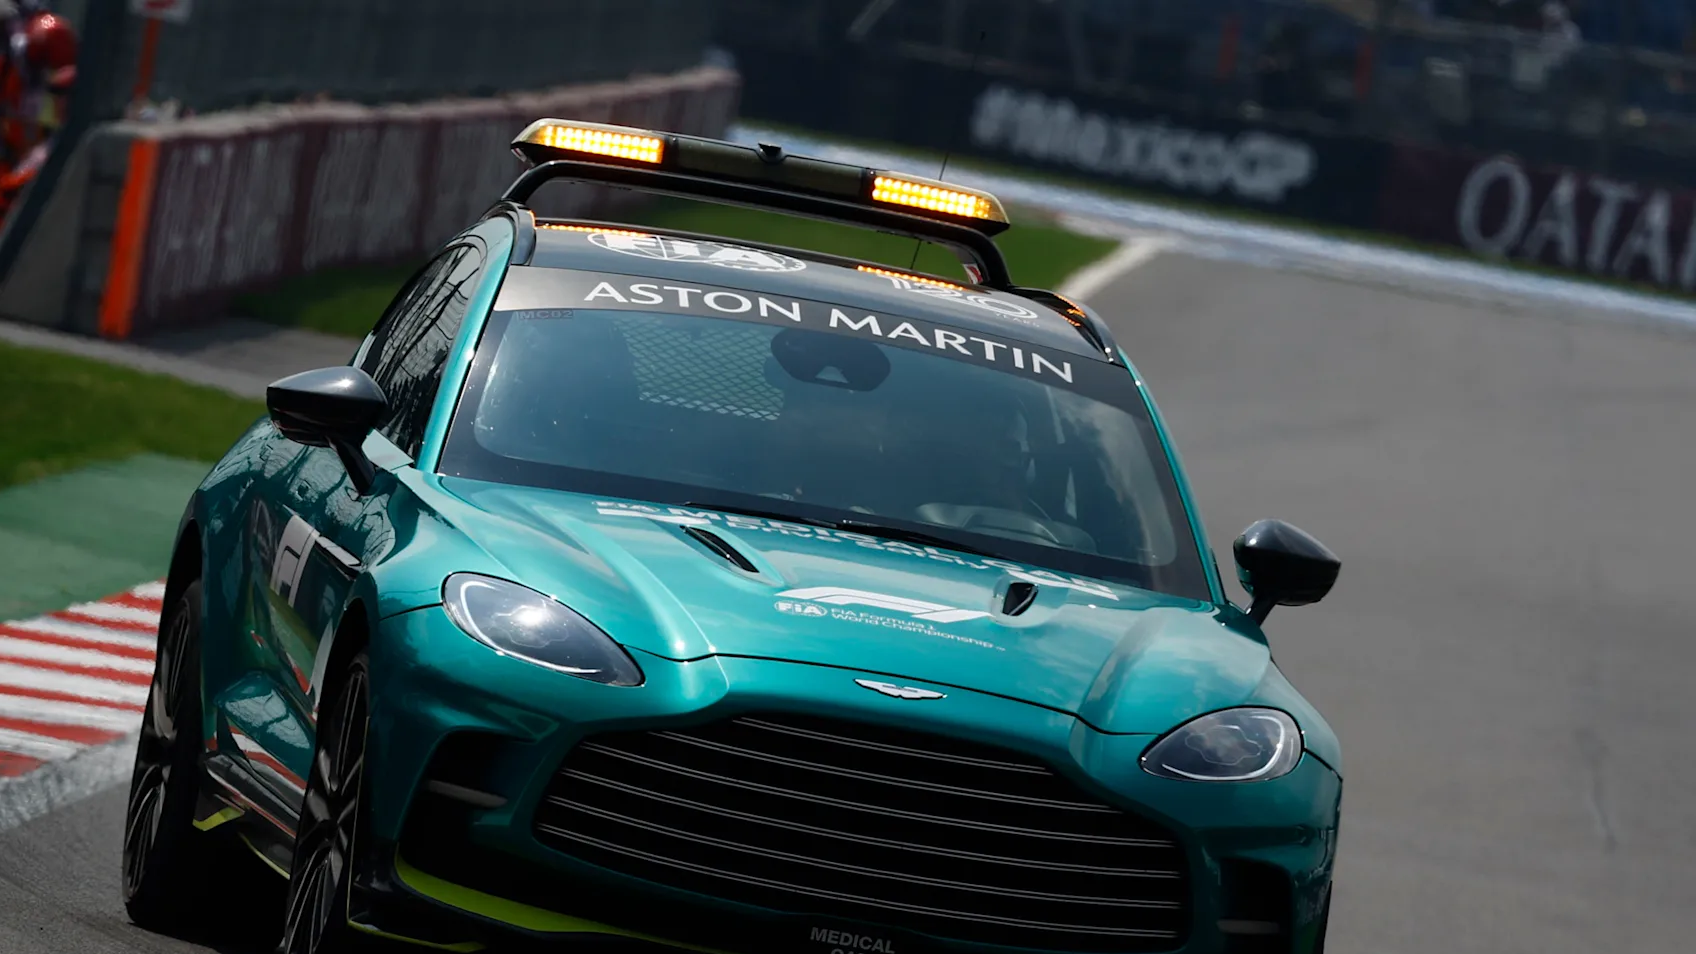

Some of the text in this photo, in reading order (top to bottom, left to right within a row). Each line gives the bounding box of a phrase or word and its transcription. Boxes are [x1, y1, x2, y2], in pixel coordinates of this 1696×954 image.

[1458, 155, 1696, 290] QATA
[601, 233, 787, 269] FIA
[583, 281, 1074, 384] ASTON MARTIN
[776, 601, 825, 617] FIA
[830, 607, 857, 618] FIA
[858, 611, 926, 630] Formula
[831, 613, 994, 649] World Championship
[810, 926, 896, 954] MEDICAL
